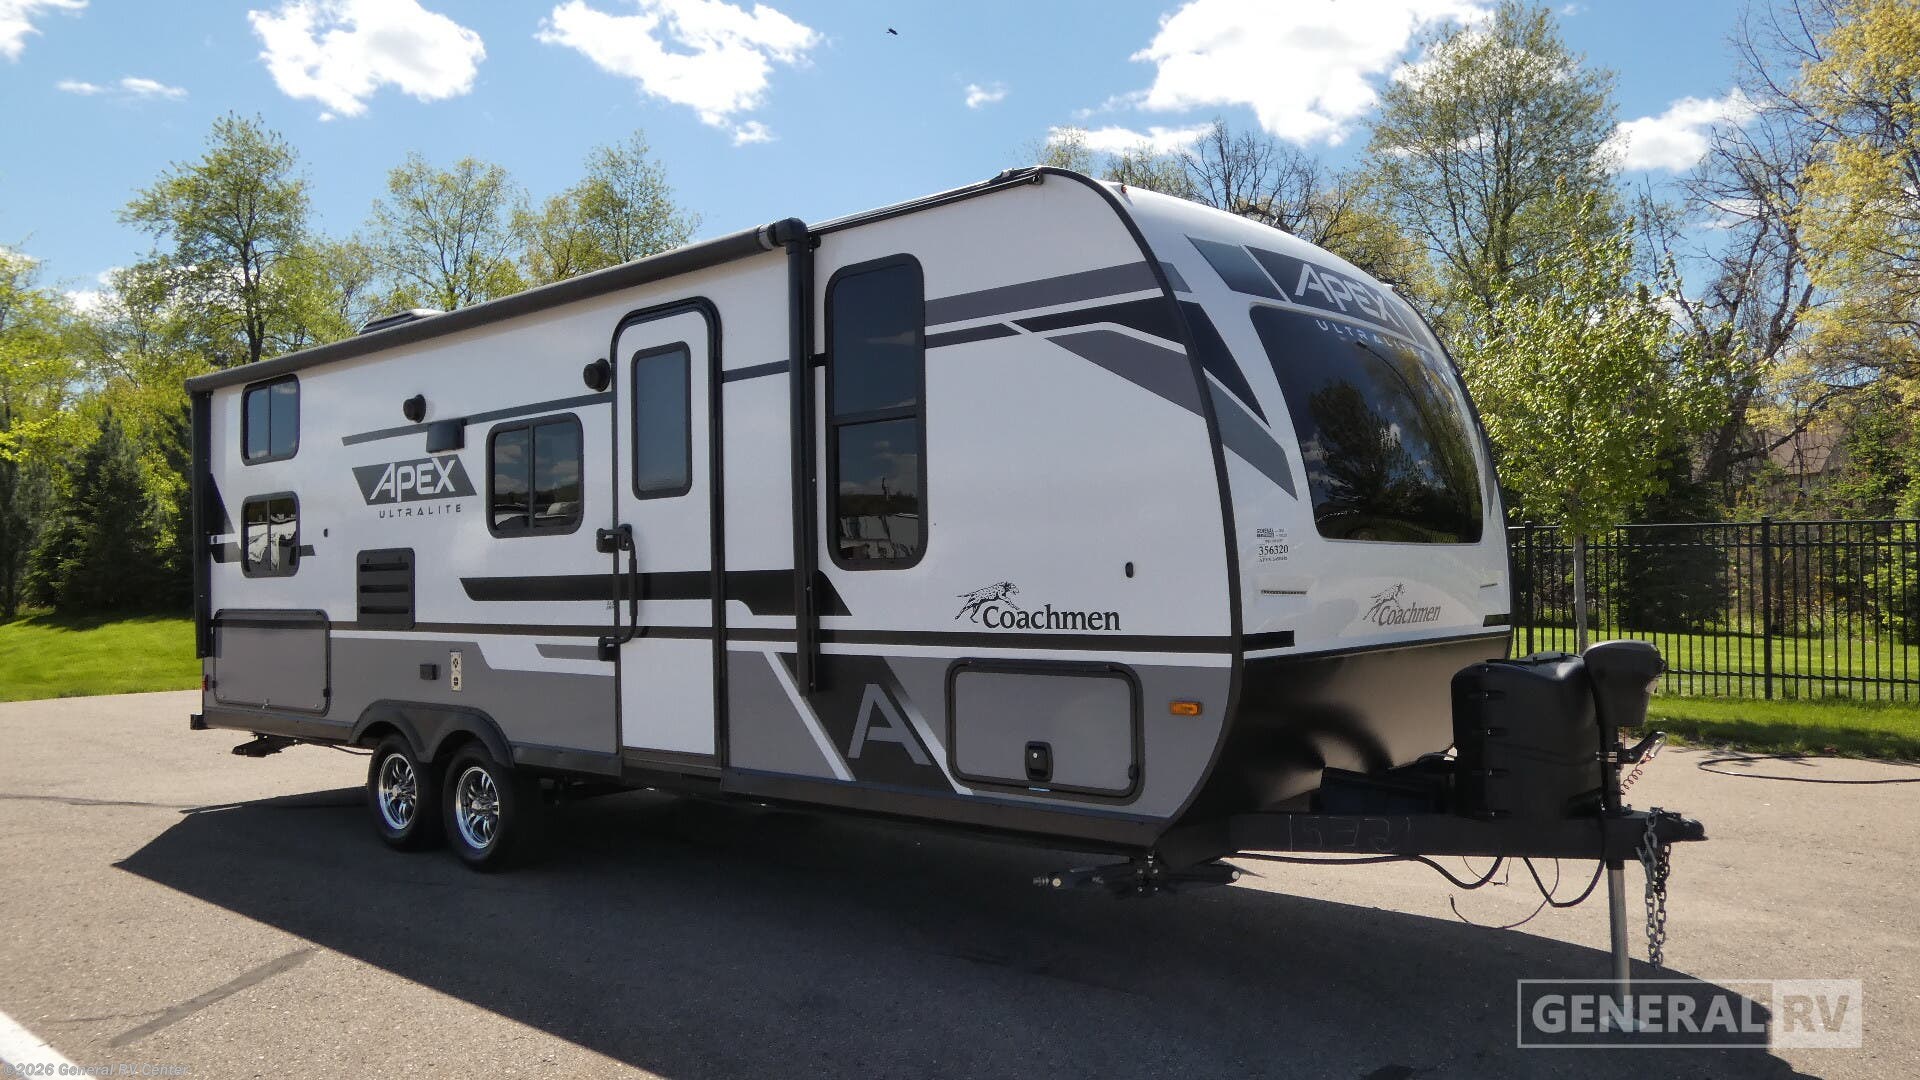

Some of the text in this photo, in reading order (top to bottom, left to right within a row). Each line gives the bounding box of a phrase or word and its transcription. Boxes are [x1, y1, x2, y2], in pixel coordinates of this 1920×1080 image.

[1295, 263, 1401, 328] APEX
[1316, 319, 1413, 351] ULTRALI
[370, 457, 456, 503] APEX
[379, 504, 461, 519] ULTRALITE
[1259, 545, 1289, 556] 356320
[982, 603, 1121, 631] Coachmen
[1378, 601, 1441, 626] Coachmen
[848, 683, 932, 766] A
